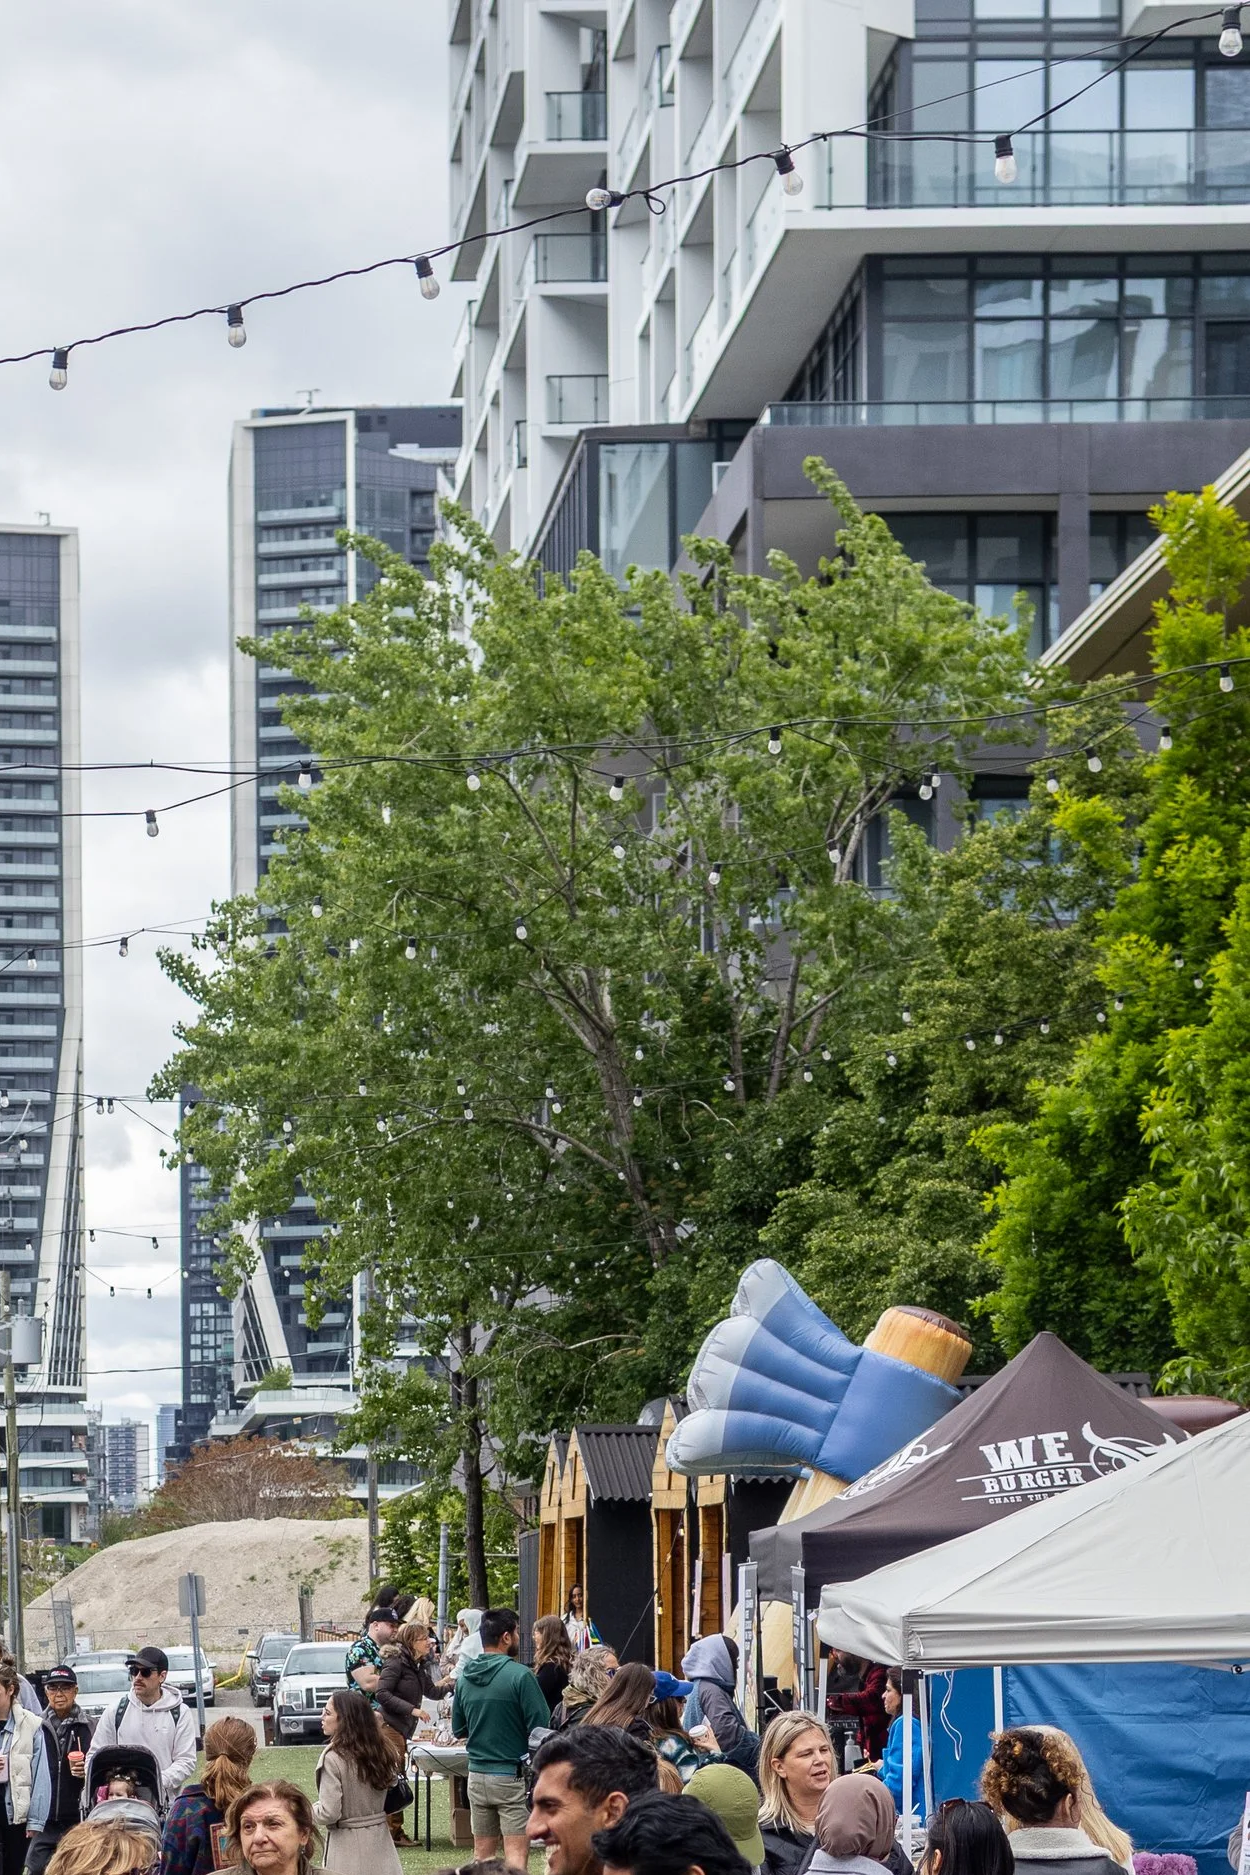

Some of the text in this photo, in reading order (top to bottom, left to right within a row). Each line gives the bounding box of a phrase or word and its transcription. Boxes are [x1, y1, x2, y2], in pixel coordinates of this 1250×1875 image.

[979, 1431, 1074, 1472] WE
[981, 1468, 1086, 1493] BURGER
[988, 1495, 1022, 1504] CHASE
[1028, 1494, 1049, 1502] THE
